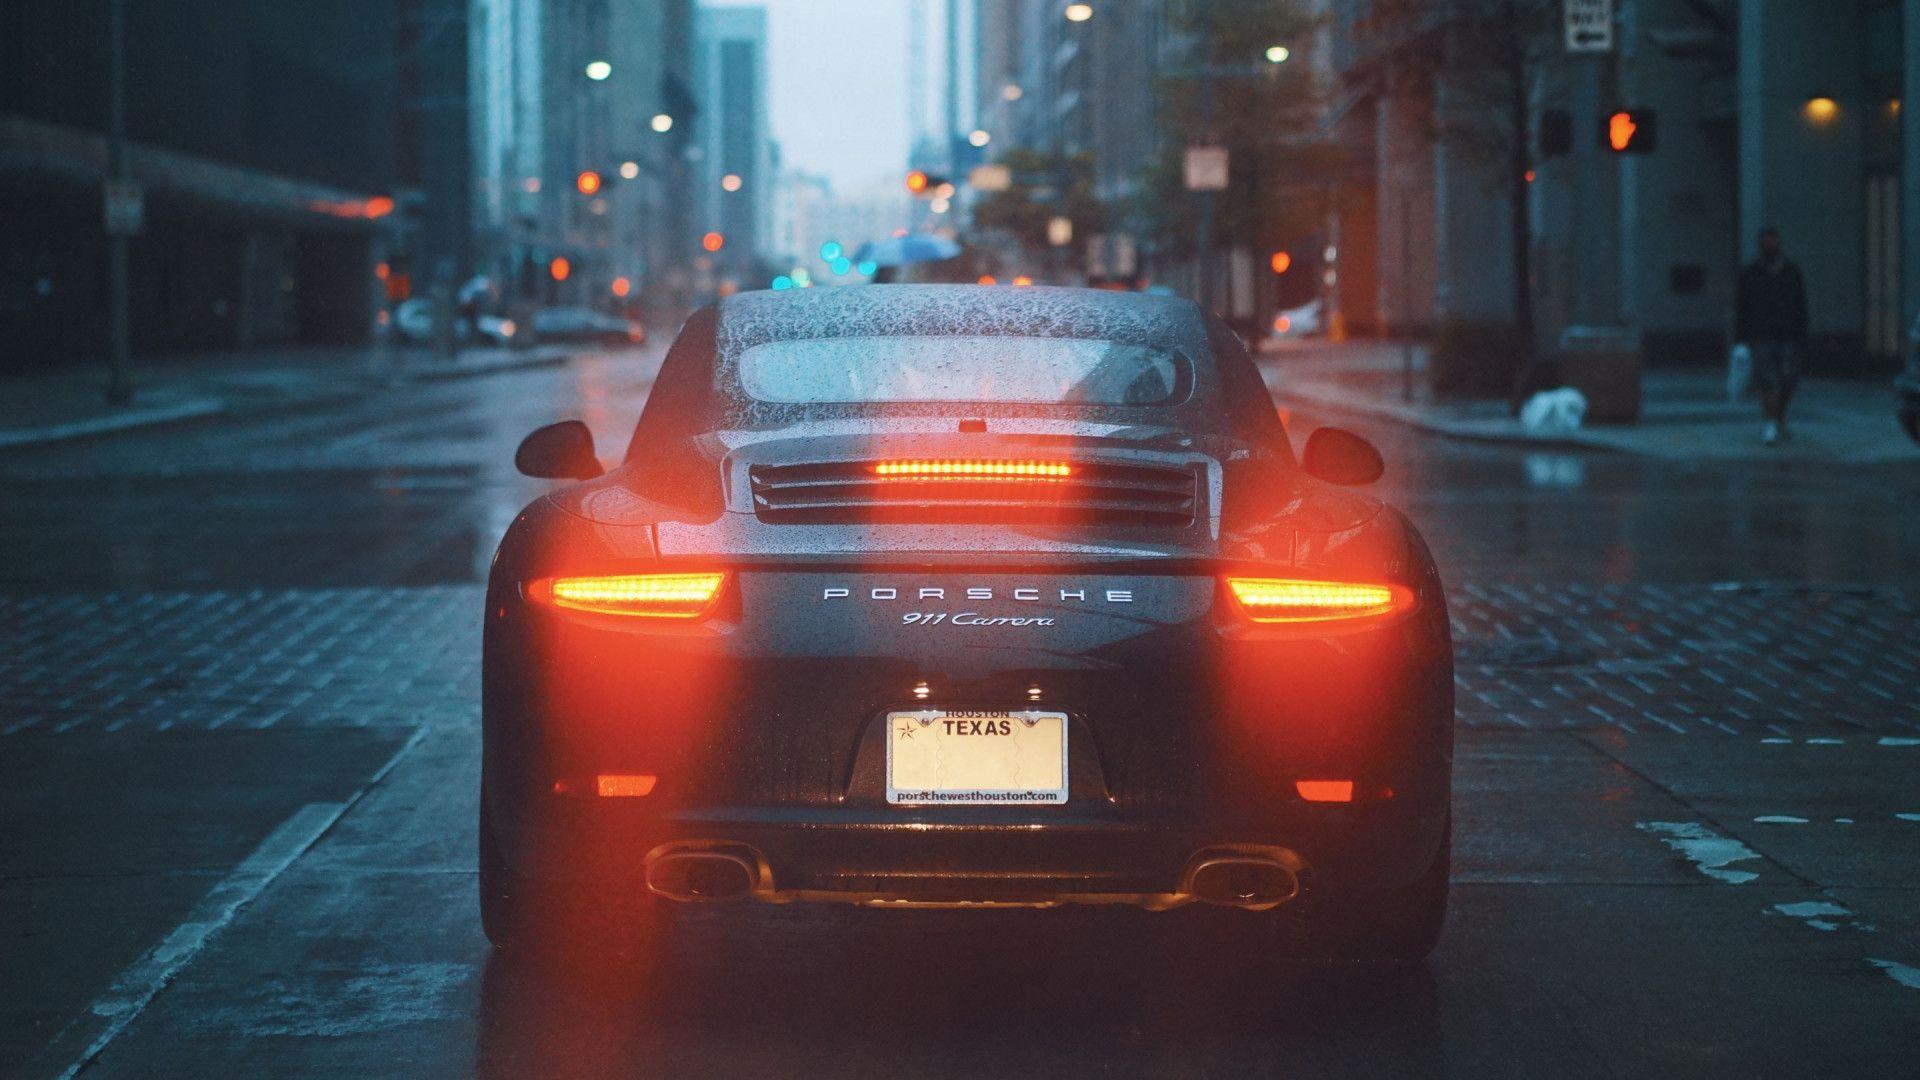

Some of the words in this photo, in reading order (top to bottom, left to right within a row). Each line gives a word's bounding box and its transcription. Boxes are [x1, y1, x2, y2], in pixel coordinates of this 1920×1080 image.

[824, 588, 1133, 602] PORSCHE
[902, 613, 947, 625] 911
[951, 613, 1055, 626] Carrera
[943, 720, 1011, 736] TEXAS
[897, 790, 1057, 802] porschewesthouston.com
